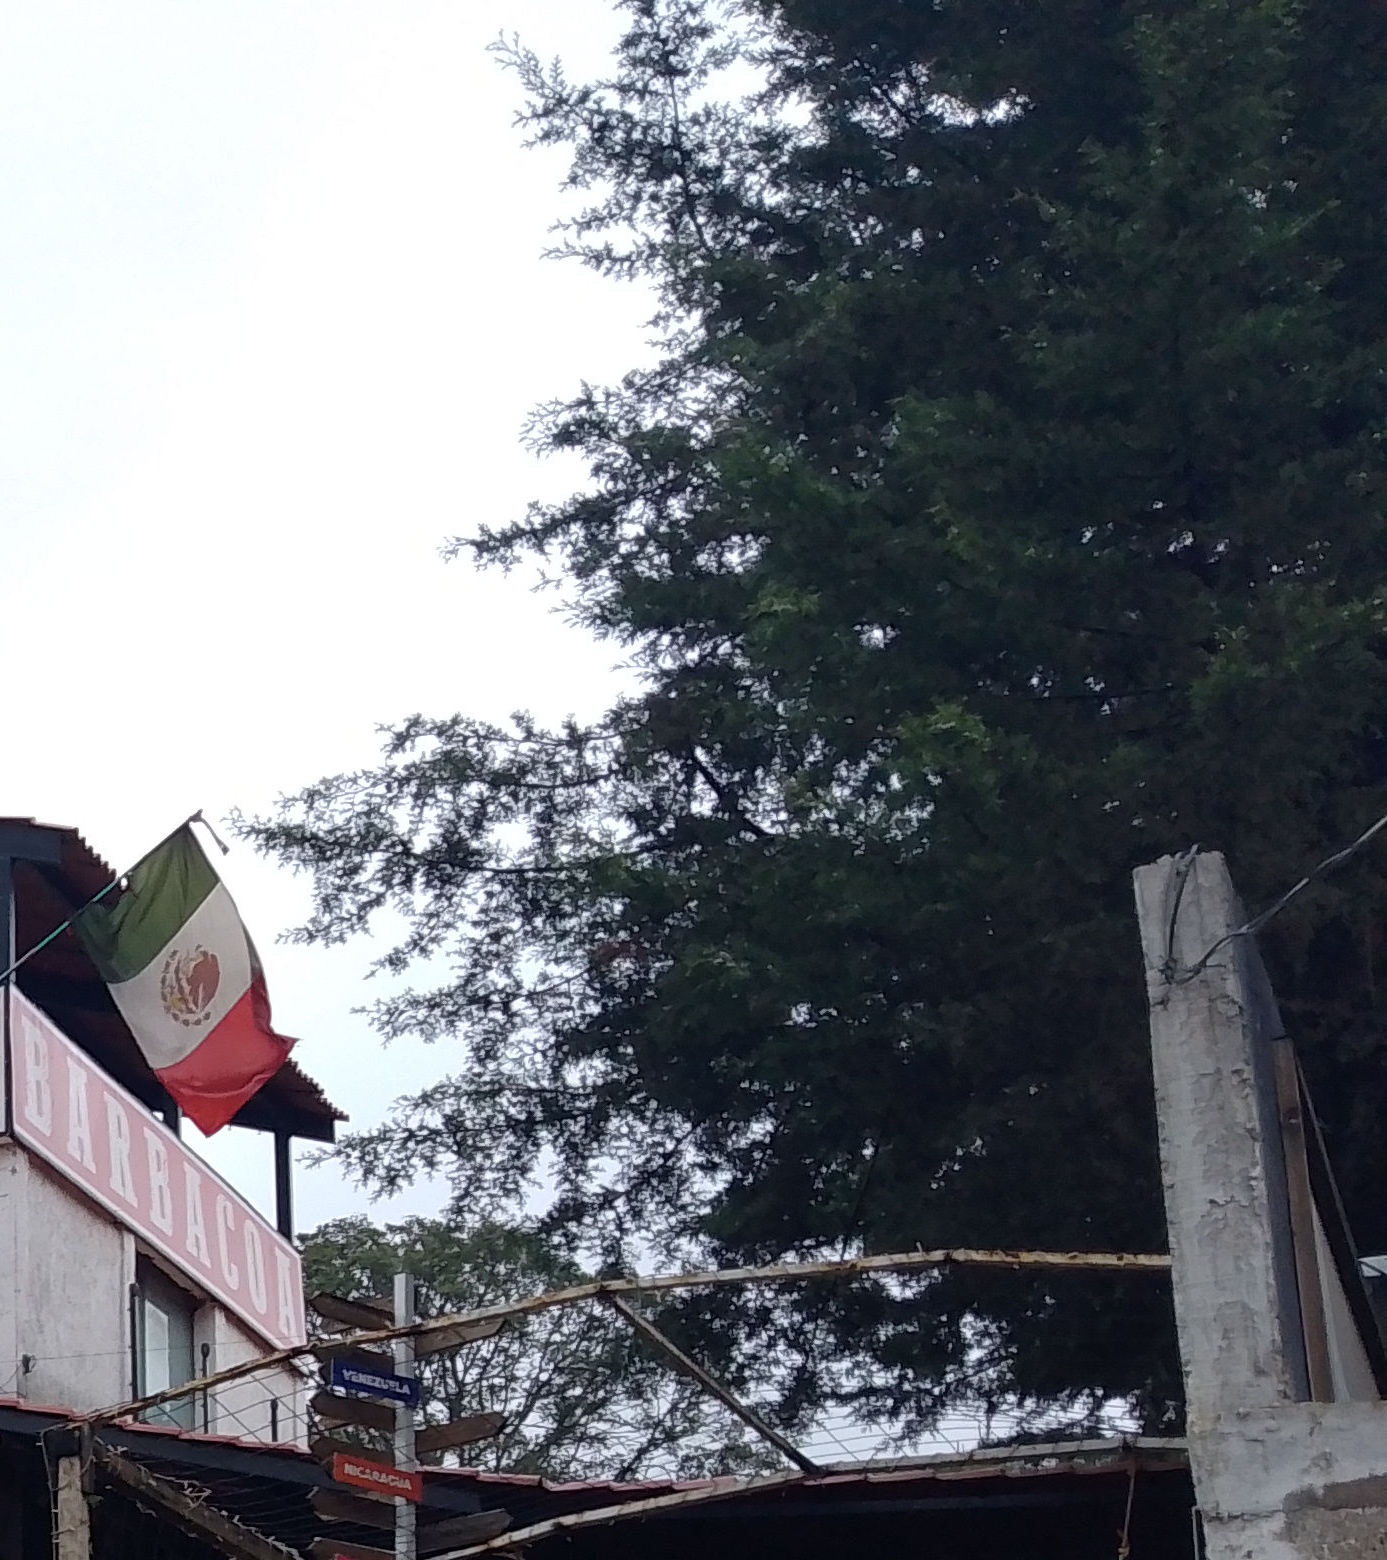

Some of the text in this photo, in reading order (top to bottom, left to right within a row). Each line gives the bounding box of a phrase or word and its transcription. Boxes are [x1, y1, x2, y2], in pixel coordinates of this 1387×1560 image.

[21, 1013, 298, 1344] BARBACOA
[342, 1367, 411, 1395] VENEZUELA
[344, 1462, 412, 1490] NICARAGUA
